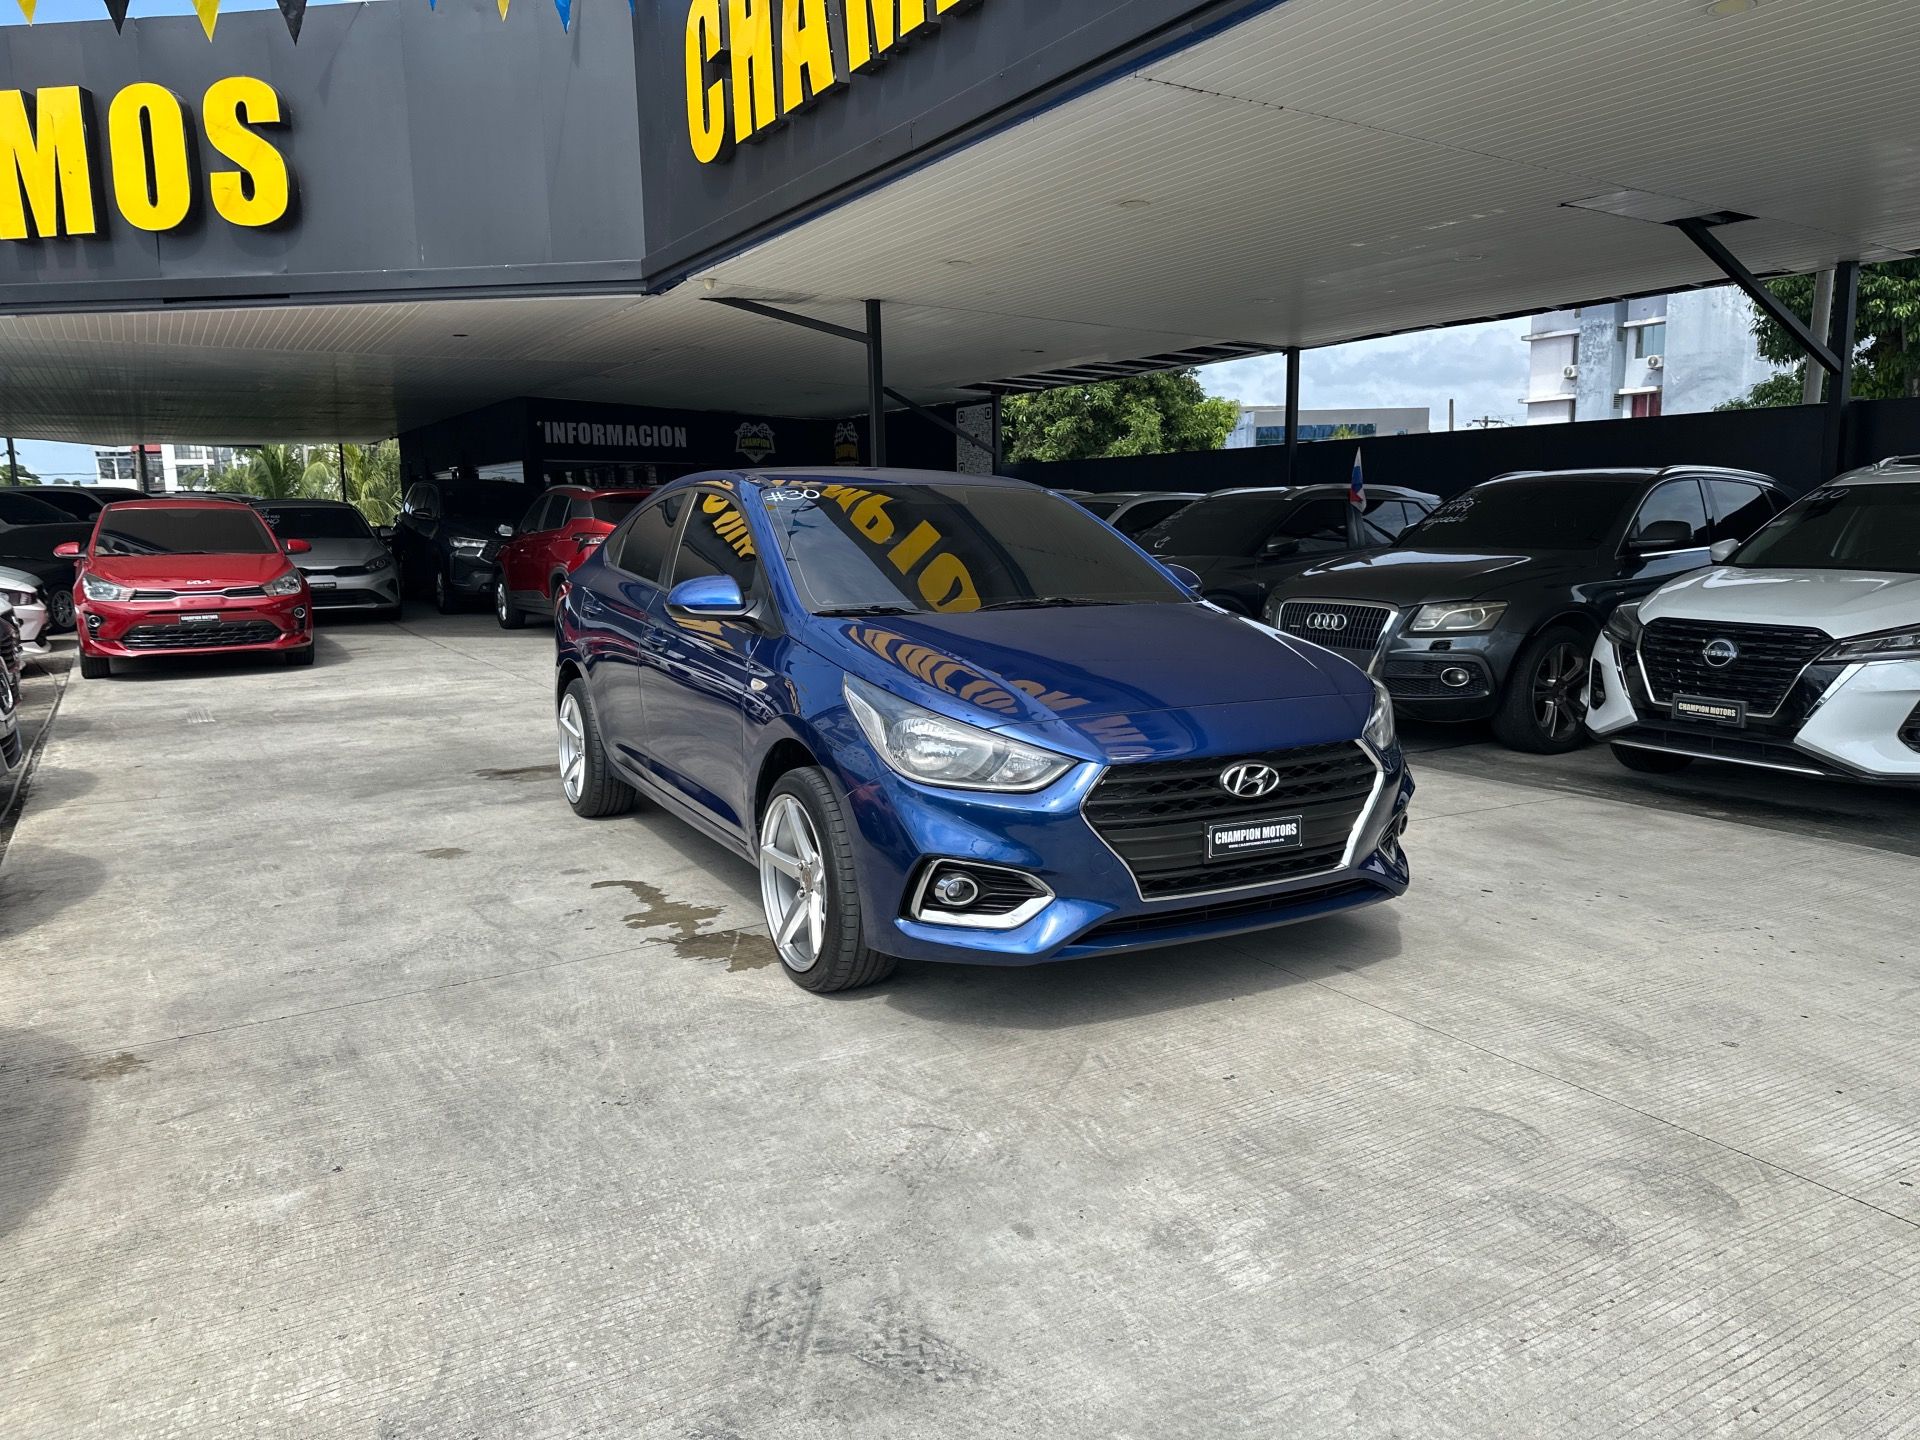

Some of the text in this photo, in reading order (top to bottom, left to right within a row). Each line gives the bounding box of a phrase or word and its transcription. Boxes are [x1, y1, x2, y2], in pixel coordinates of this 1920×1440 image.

[544, 421, 687, 448] INFORMACION
[765, 489, 820, 502] #30
[1702, 649, 1737, 658] NISSAN
[1678, 703, 1709, 713] CHAMPION
[1710, 706, 1736, 717] MOTORS
[1215, 823, 1297, 844] CHAMPION MOTORS
